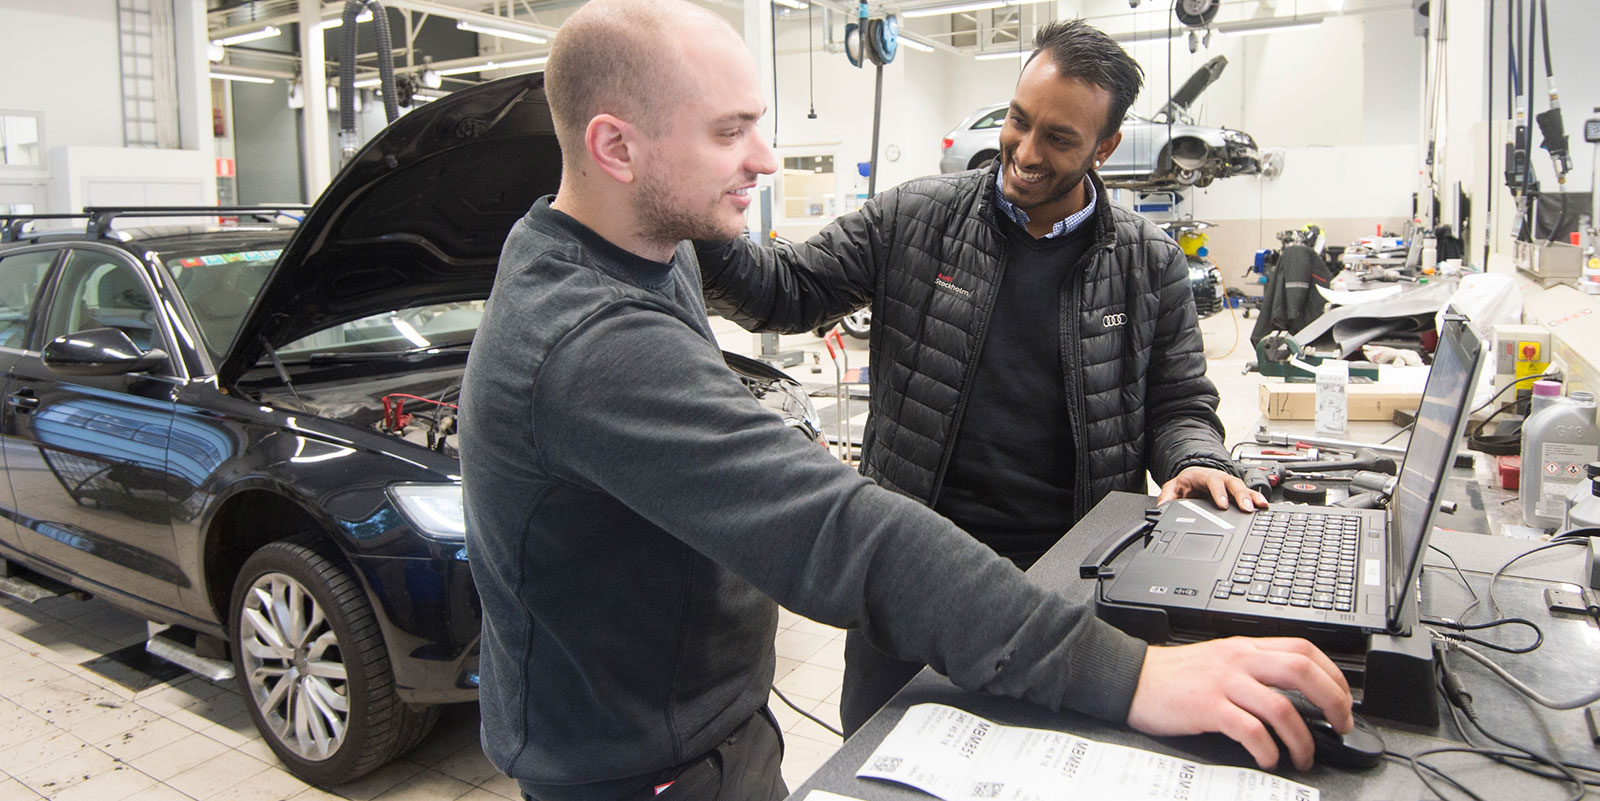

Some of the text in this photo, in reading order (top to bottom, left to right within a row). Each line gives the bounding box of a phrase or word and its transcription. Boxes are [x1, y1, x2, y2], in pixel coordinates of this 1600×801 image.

[935, 278, 969, 296] Stockholm
[937, 272, 953, 283] Audi
[960, 720, 991, 759] MBM851
[1060, 741, 1089, 778] MBM851
